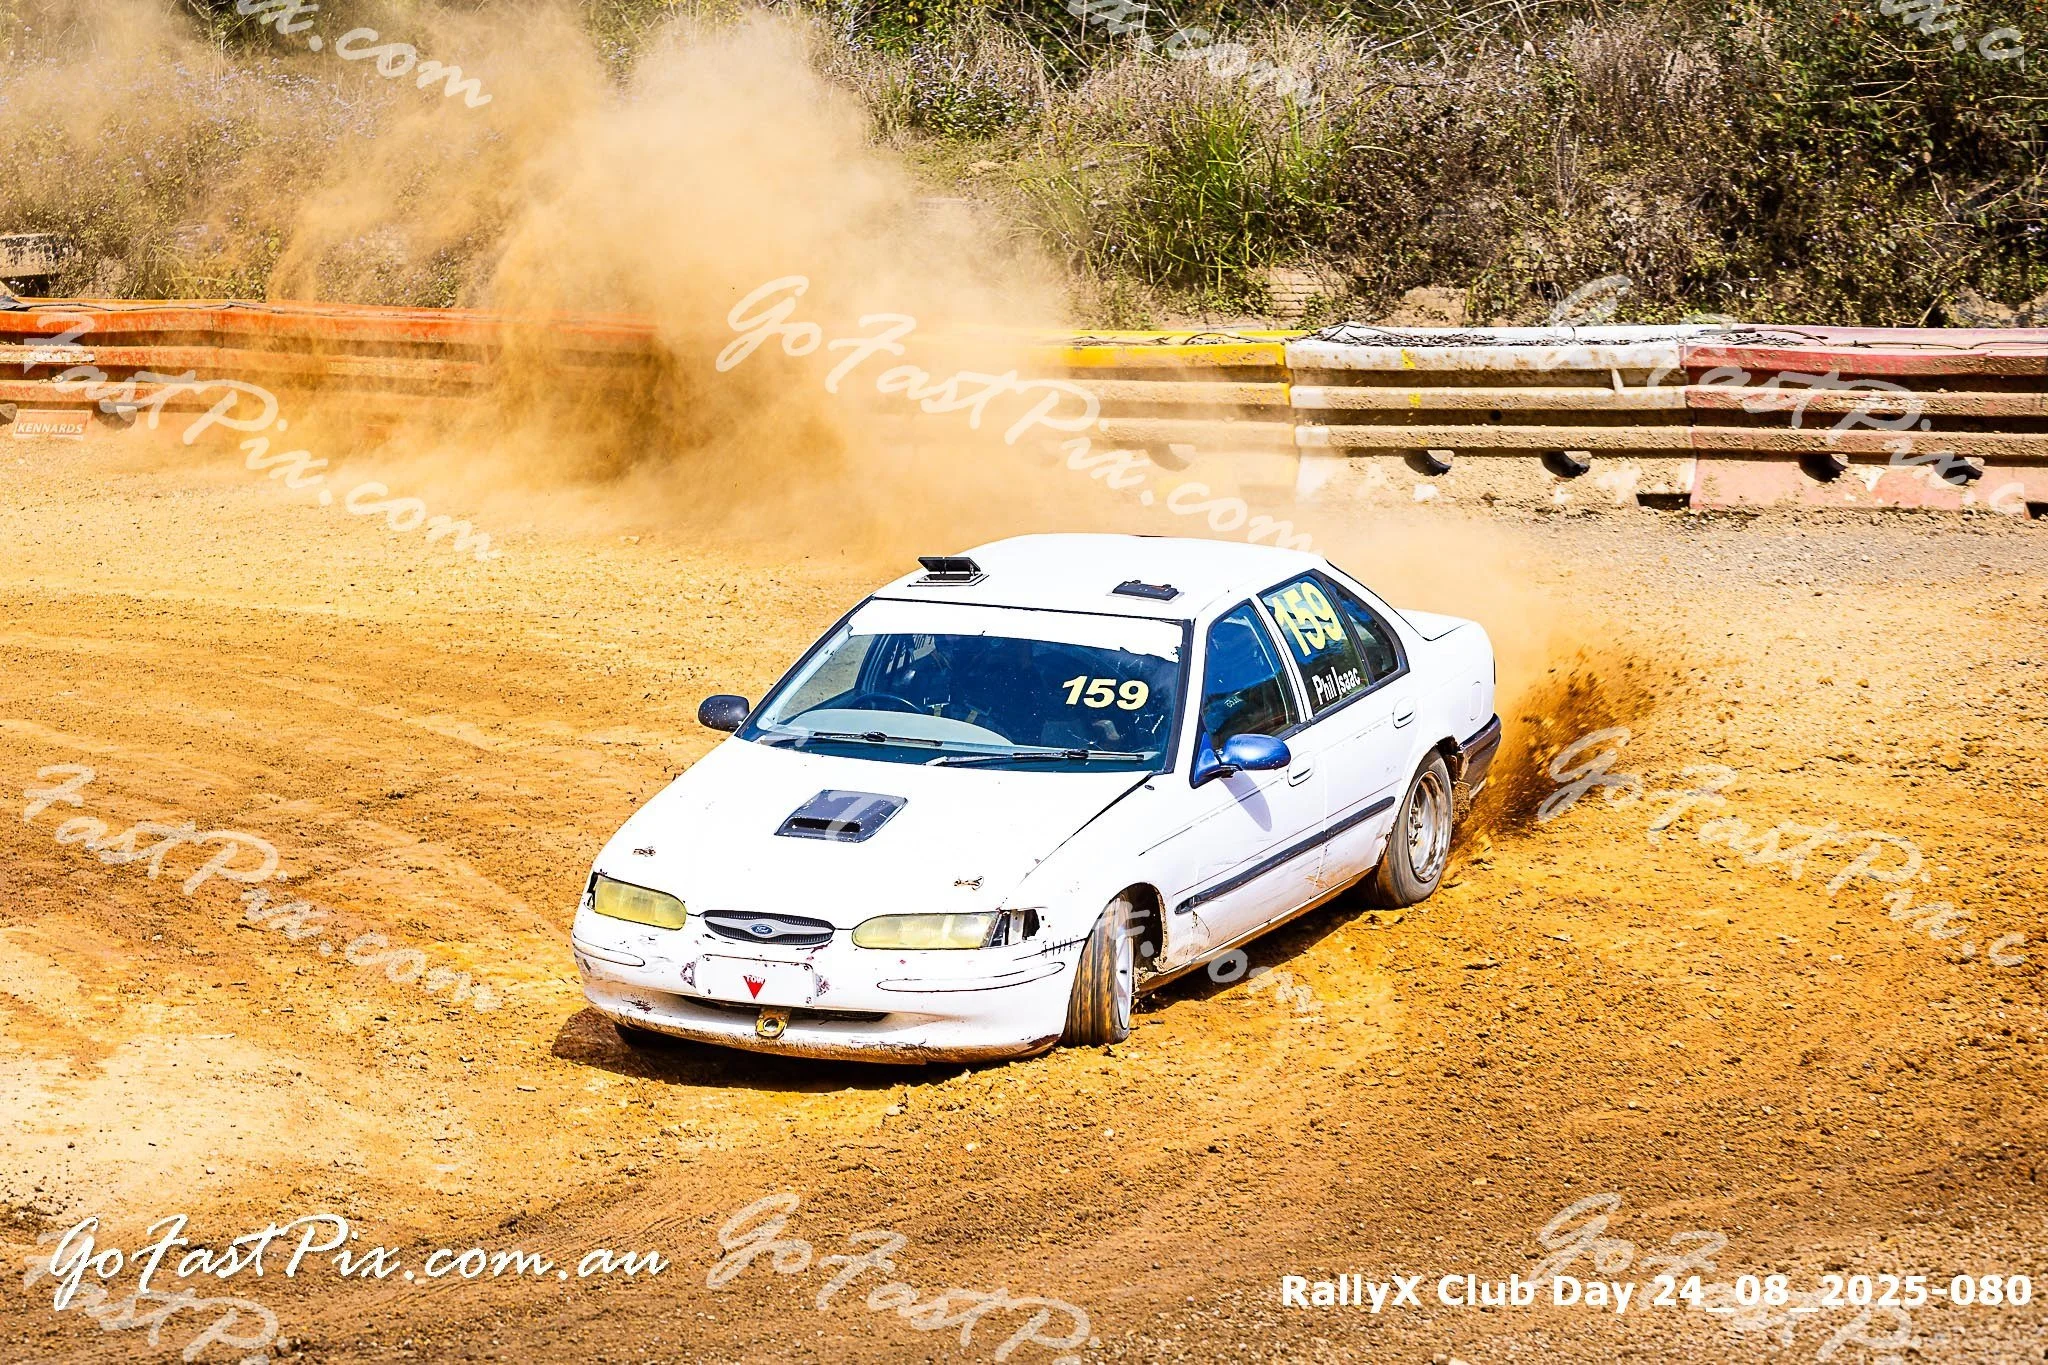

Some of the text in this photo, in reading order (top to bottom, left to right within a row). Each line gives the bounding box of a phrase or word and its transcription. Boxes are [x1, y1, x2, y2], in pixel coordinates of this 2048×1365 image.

[18, 423, 83, 434] KENNARDS
[1271, 582, 1343, 657] 159
[1062, 675, 1150, 711] 159
[1312, 666, 1361, 705] Phil Isaac
